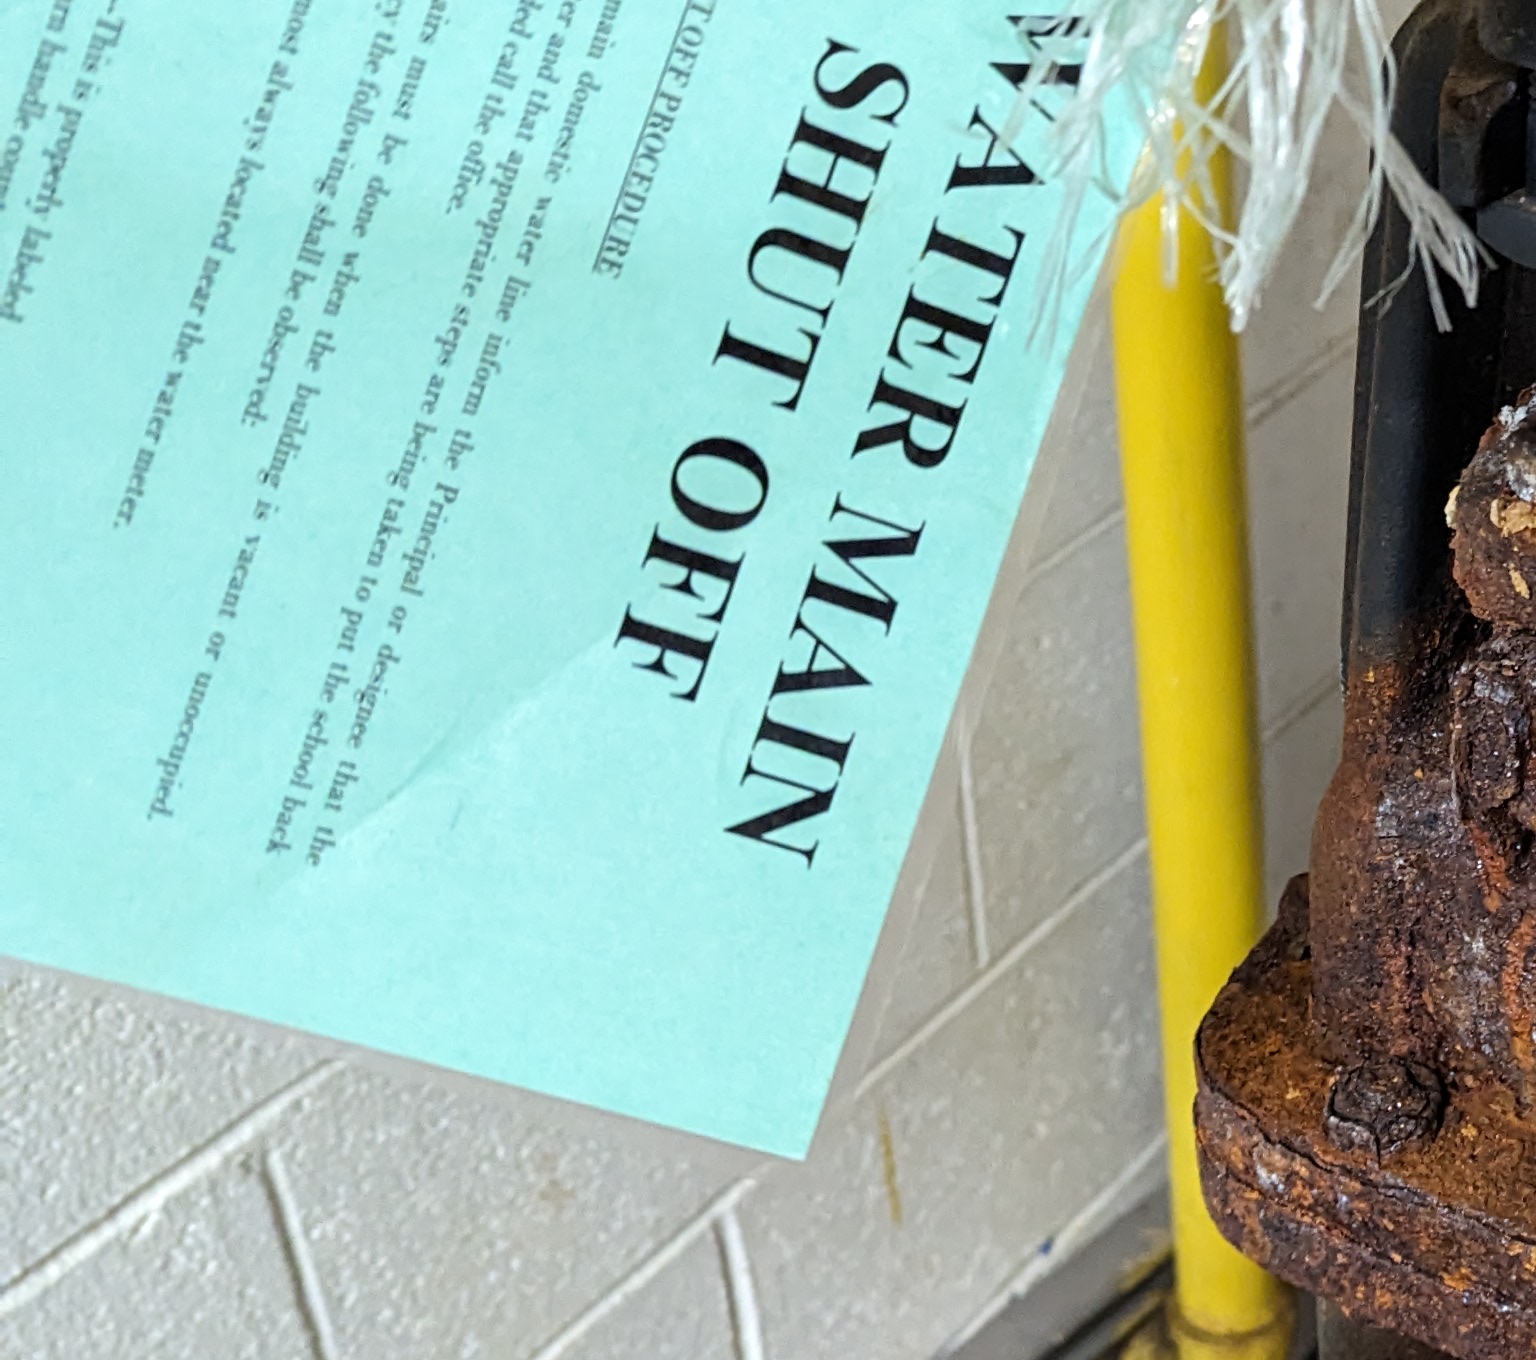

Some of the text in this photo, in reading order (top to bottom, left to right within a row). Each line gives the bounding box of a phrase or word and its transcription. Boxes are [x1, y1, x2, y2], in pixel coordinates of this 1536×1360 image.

[13, 37, 68, 131] handle
[363, 30, 396, 74] the
[490, 40, 518, 90] call
[536, 31, 565, 84] and
[669, 23, 704, 88] OFF
[71, 77, 101, 101] is
[244, 59, 293, 151] always
[391, 55, 427, 121] must
[474, 92, 506, 135] the
[514, 88, 551, 142] that
[312, 77, 381, 199] following
[377, 132, 409, 165] be
[544, 70, 601, 184] domestic
[25, 103, 83, 221] properly
[445, 139, 486, 214] office.
[597, 89, 682, 279] PROCEDURE
[209, 155, 265, 254] located
[296, 201, 336, 267] shall
[351, 174, 391, 238] done
[461, 149, 523, 298] appropriate
[515, 196, 552, 267] water
[0, 224, 52, 323] labeled
[188, 255, 221, 317] near
[283, 268, 317, 301] be
[322, 251, 360, 316] when
[495, 274, 532, 323] line
[171, 320, 205, 364] the
[240, 304, 299, 427] observed:
[304, 328, 336, 372] the
[435, 303, 470, 367] steps
[420, 372, 445, 415] are
[461, 332, 510, 416] inform
[615, 38, 910, 703] SHUT OFF
[144, 370, 183, 445] water
[256, 382, 321, 490] building
[724, 13, 1082, 864] WATER MAIN
[386, 420, 437, 491] being
[443, 428, 474, 471] the
[112, 446, 155, 528] meter.
[253, 498, 279, 521] is
[366, 497, 405, 567] taken
[399, 481, 460, 597] Principal
[217, 534, 260, 619] vacant
[355, 575, 378, 602] to
[205, 631, 225, 662] or
[336, 606, 364, 653] put
[387, 604, 407, 634] or
[319, 661, 350, 703] the
[346, 643, 400, 749] designee
[146, 671, 212, 820] unoccupied.
[288, 708, 329, 790] school
[323, 760, 359, 812] that
[264, 794, 307, 855] back
[304, 825, 336, 867] the
